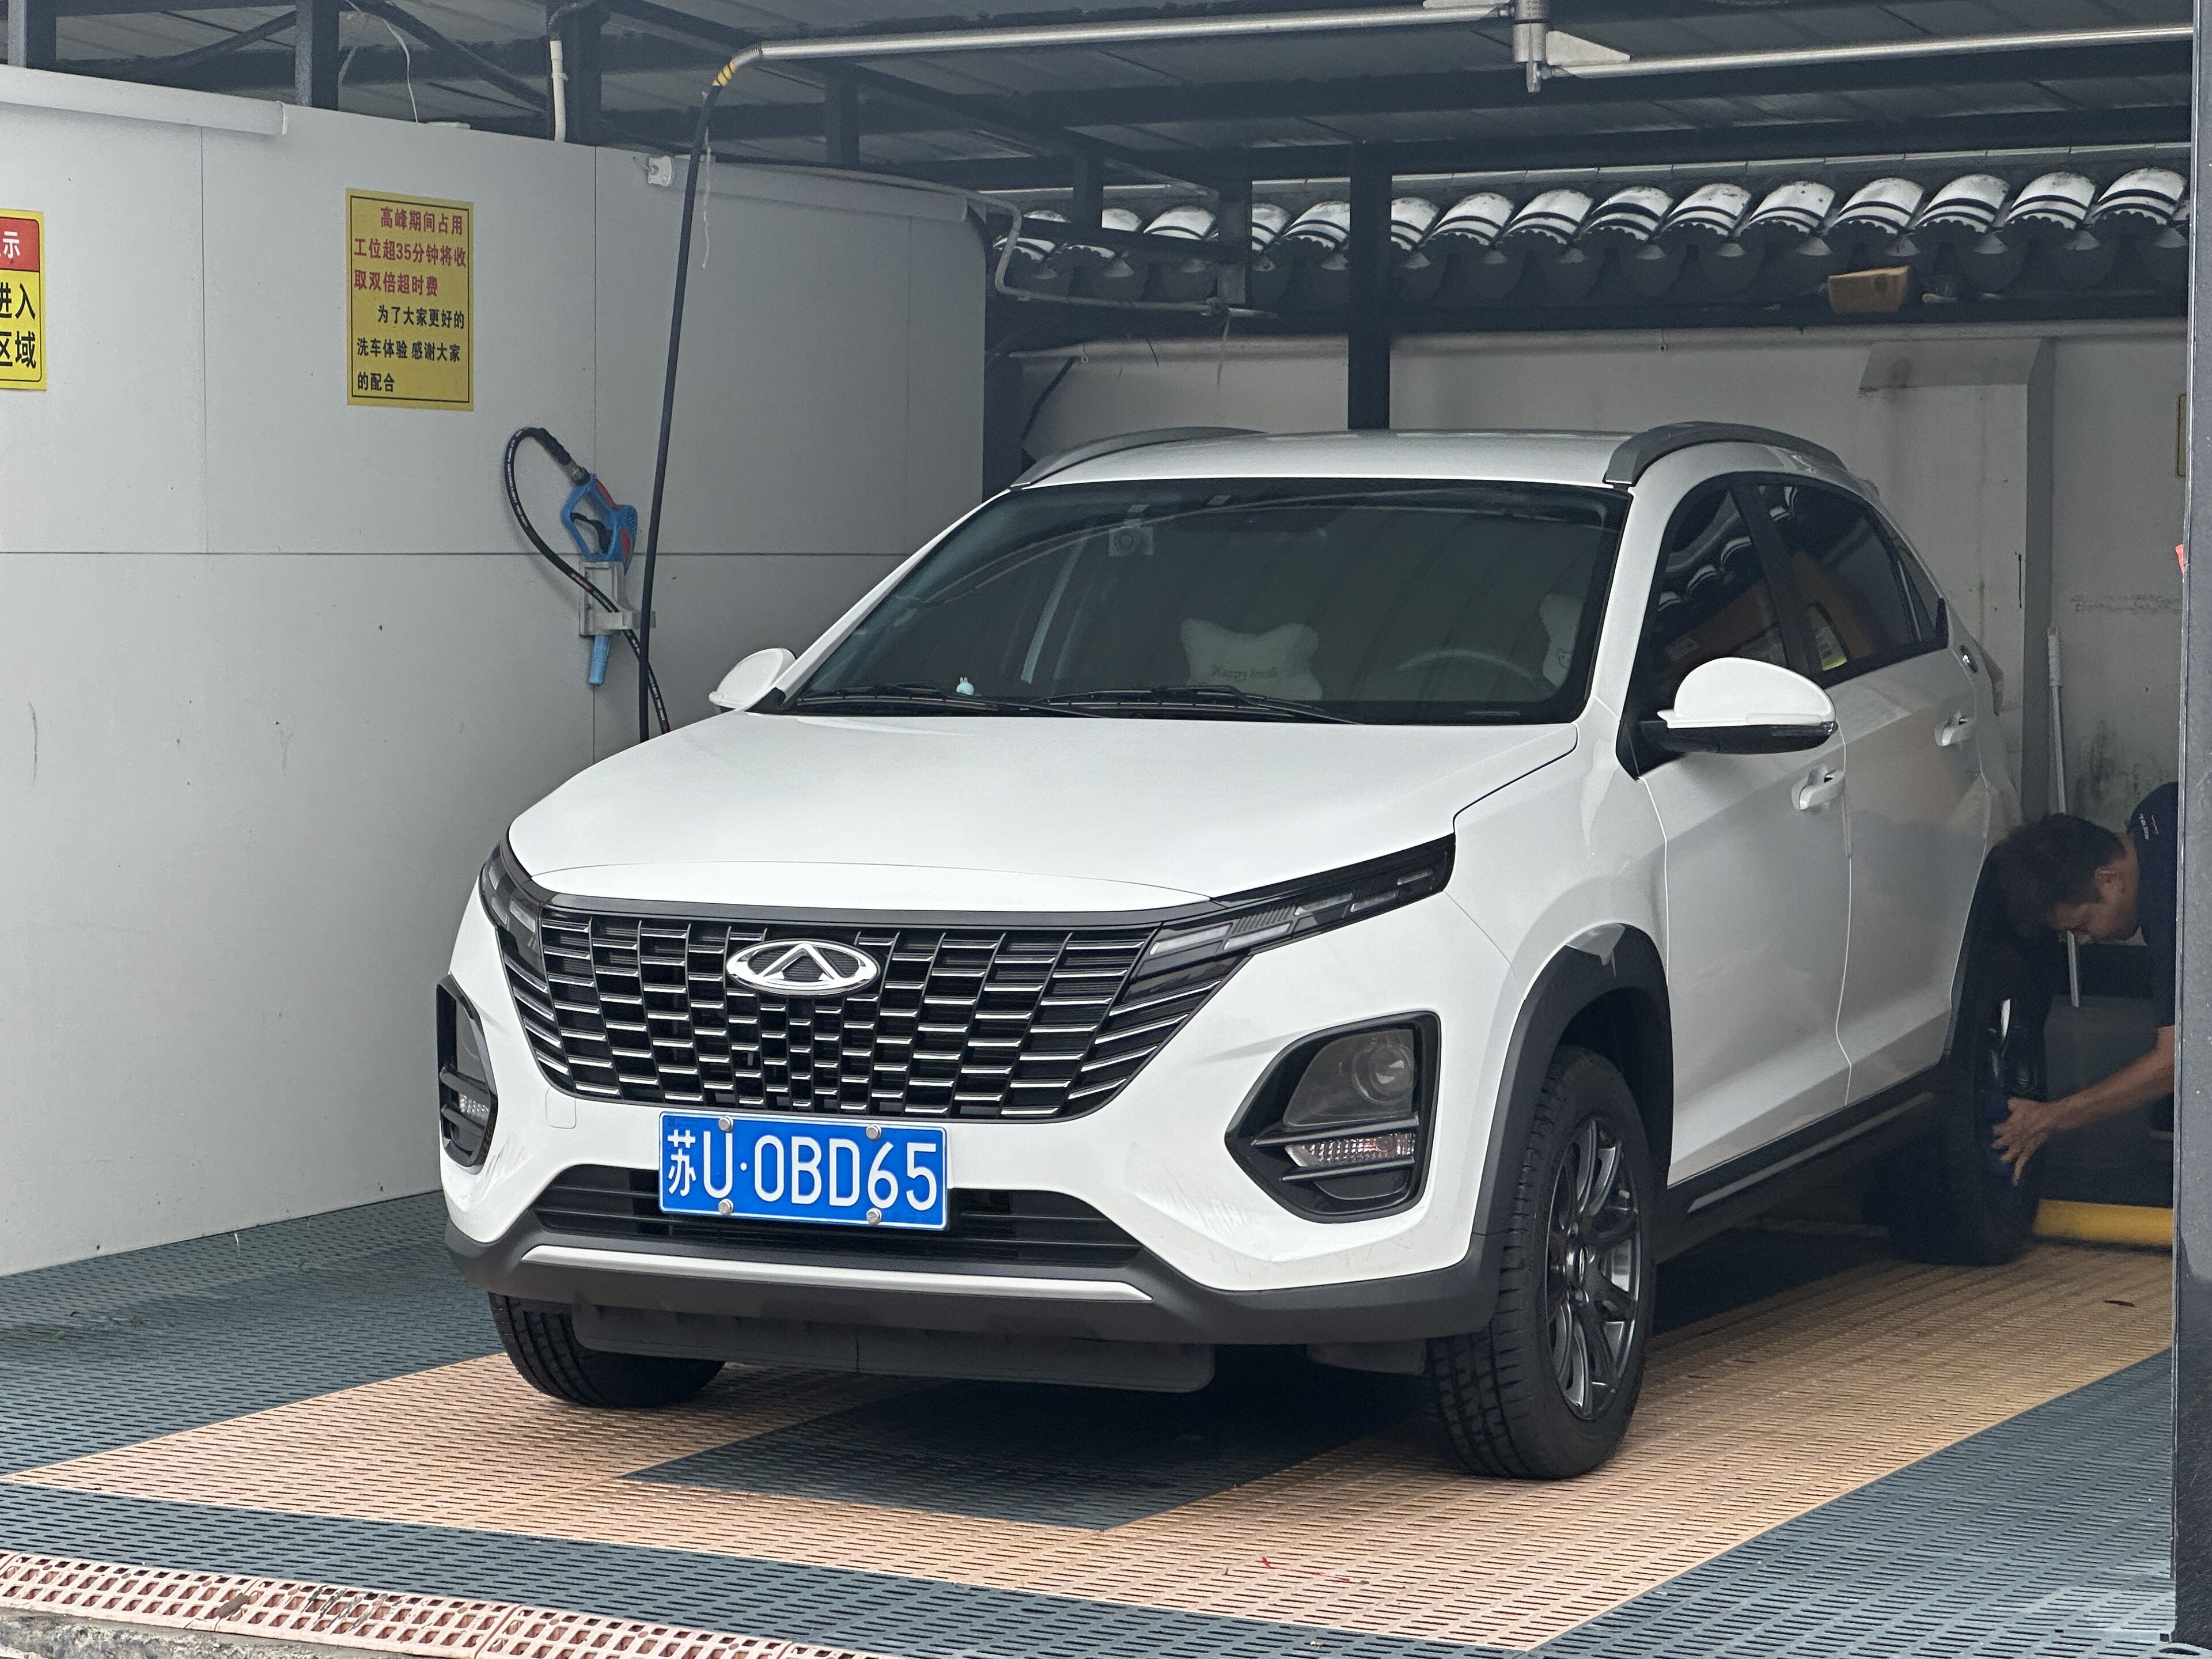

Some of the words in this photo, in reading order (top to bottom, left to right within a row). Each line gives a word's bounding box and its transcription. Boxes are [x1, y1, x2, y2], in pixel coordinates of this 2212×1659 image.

[380, 206, 463, 235] 高峰期间占用
[0, 230, 21, 259] 示
[354, 238, 466, 267] 工位超35分钟将收
[354, 269, 438, 297] 取双倍超时费
[378, 304, 464, 329] 为了大家更好的
[0, 331, 36, 369] 区域
[357, 338, 407, 359] 洗车体验
[411, 341, 460, 362] 感谢大家
[357, 372, 395, 392] 的配合
